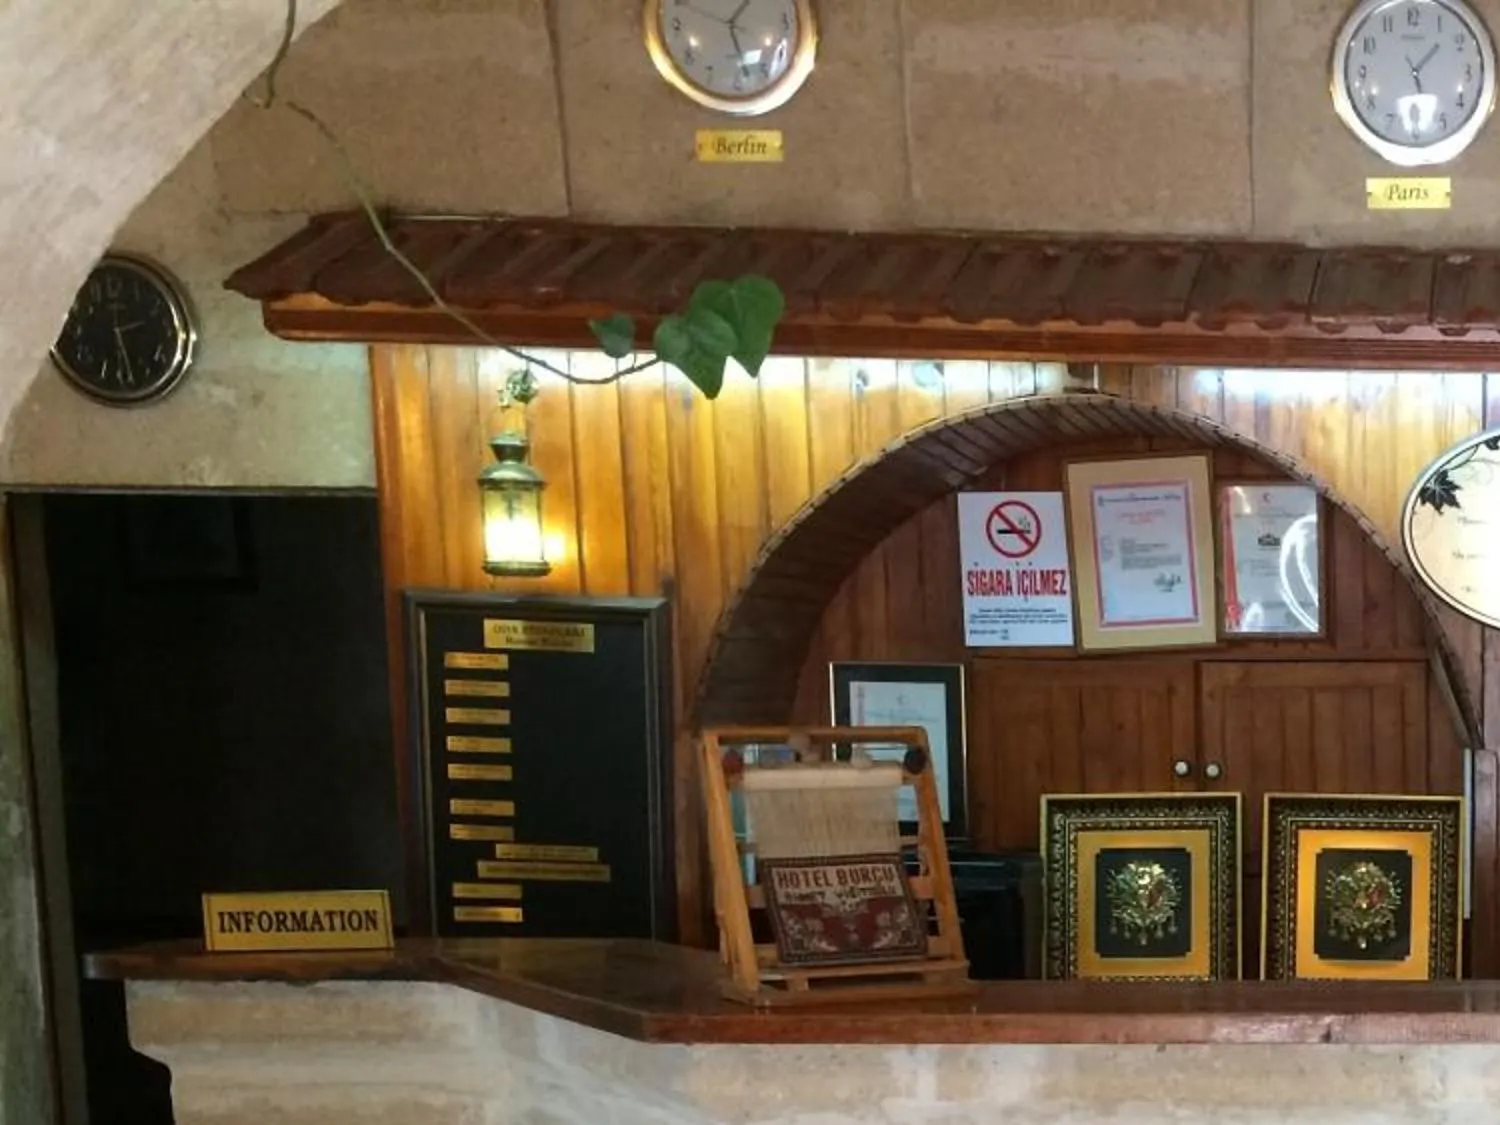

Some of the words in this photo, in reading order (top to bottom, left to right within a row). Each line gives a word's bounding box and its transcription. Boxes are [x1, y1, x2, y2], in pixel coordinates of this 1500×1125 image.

[715, 135, 767, 154] Berlin
[1387, 183, 1429, 201] Paris
[777, 868, 834, 890] HOTEL
[836, 864, 895, 887] BURCU
[217, 909, 379, 934] INFORMATION
